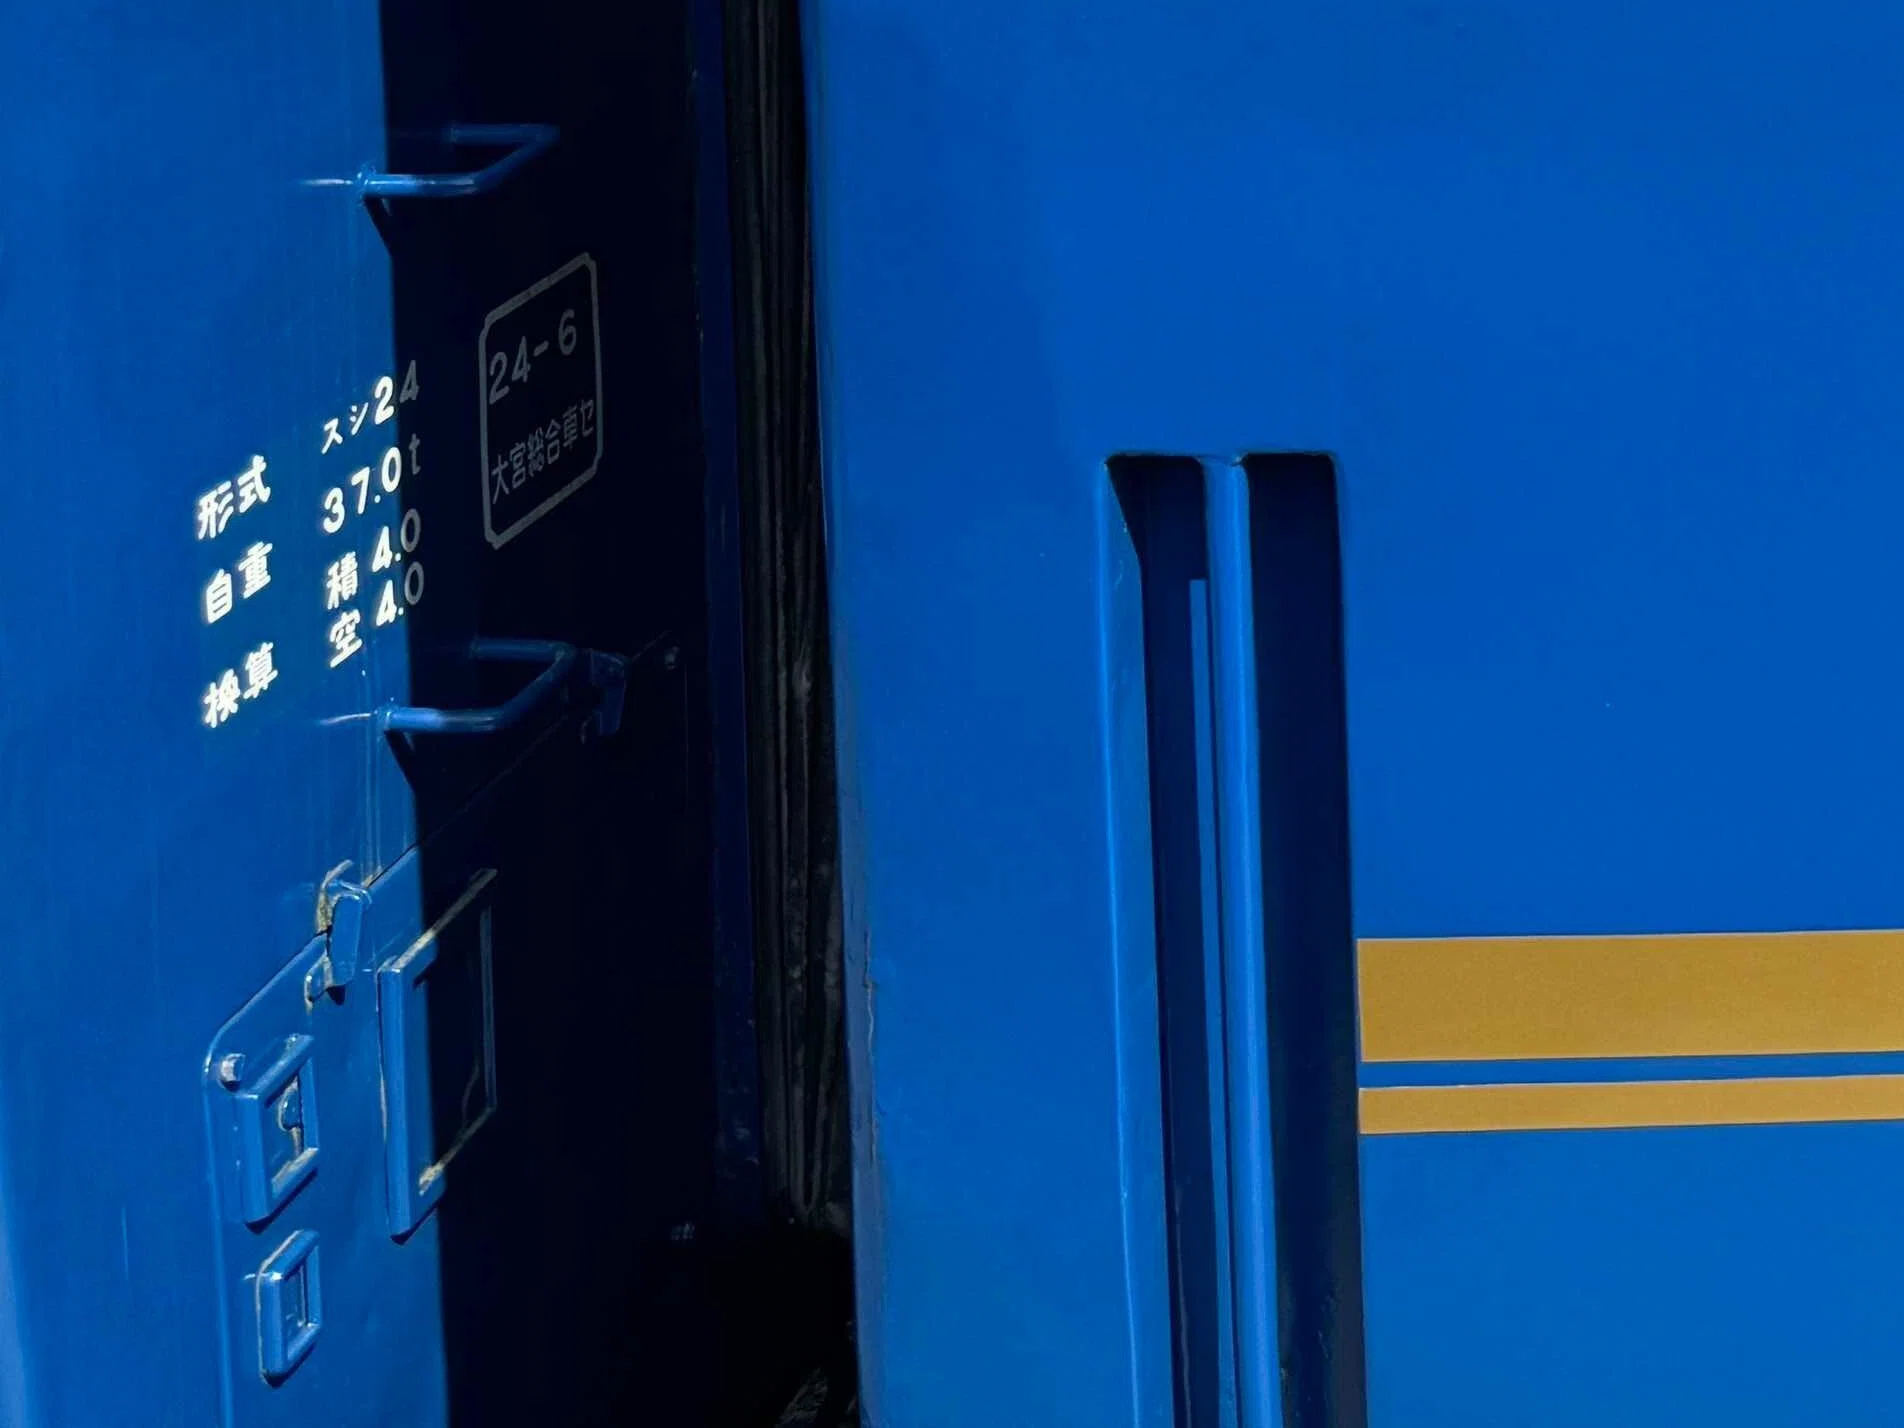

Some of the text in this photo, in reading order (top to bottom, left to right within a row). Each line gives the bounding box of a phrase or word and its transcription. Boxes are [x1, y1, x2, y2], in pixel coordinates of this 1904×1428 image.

[488, 307, 577, 406] 24-6
[199, 455, 271, 540] 形式
[206, 541, 273, 624] 自重
[327, 507, 422, 609] 積 4.0
[329, 560, 425, 669] 空 4.0
[204, 642, 278, 728] 換算
